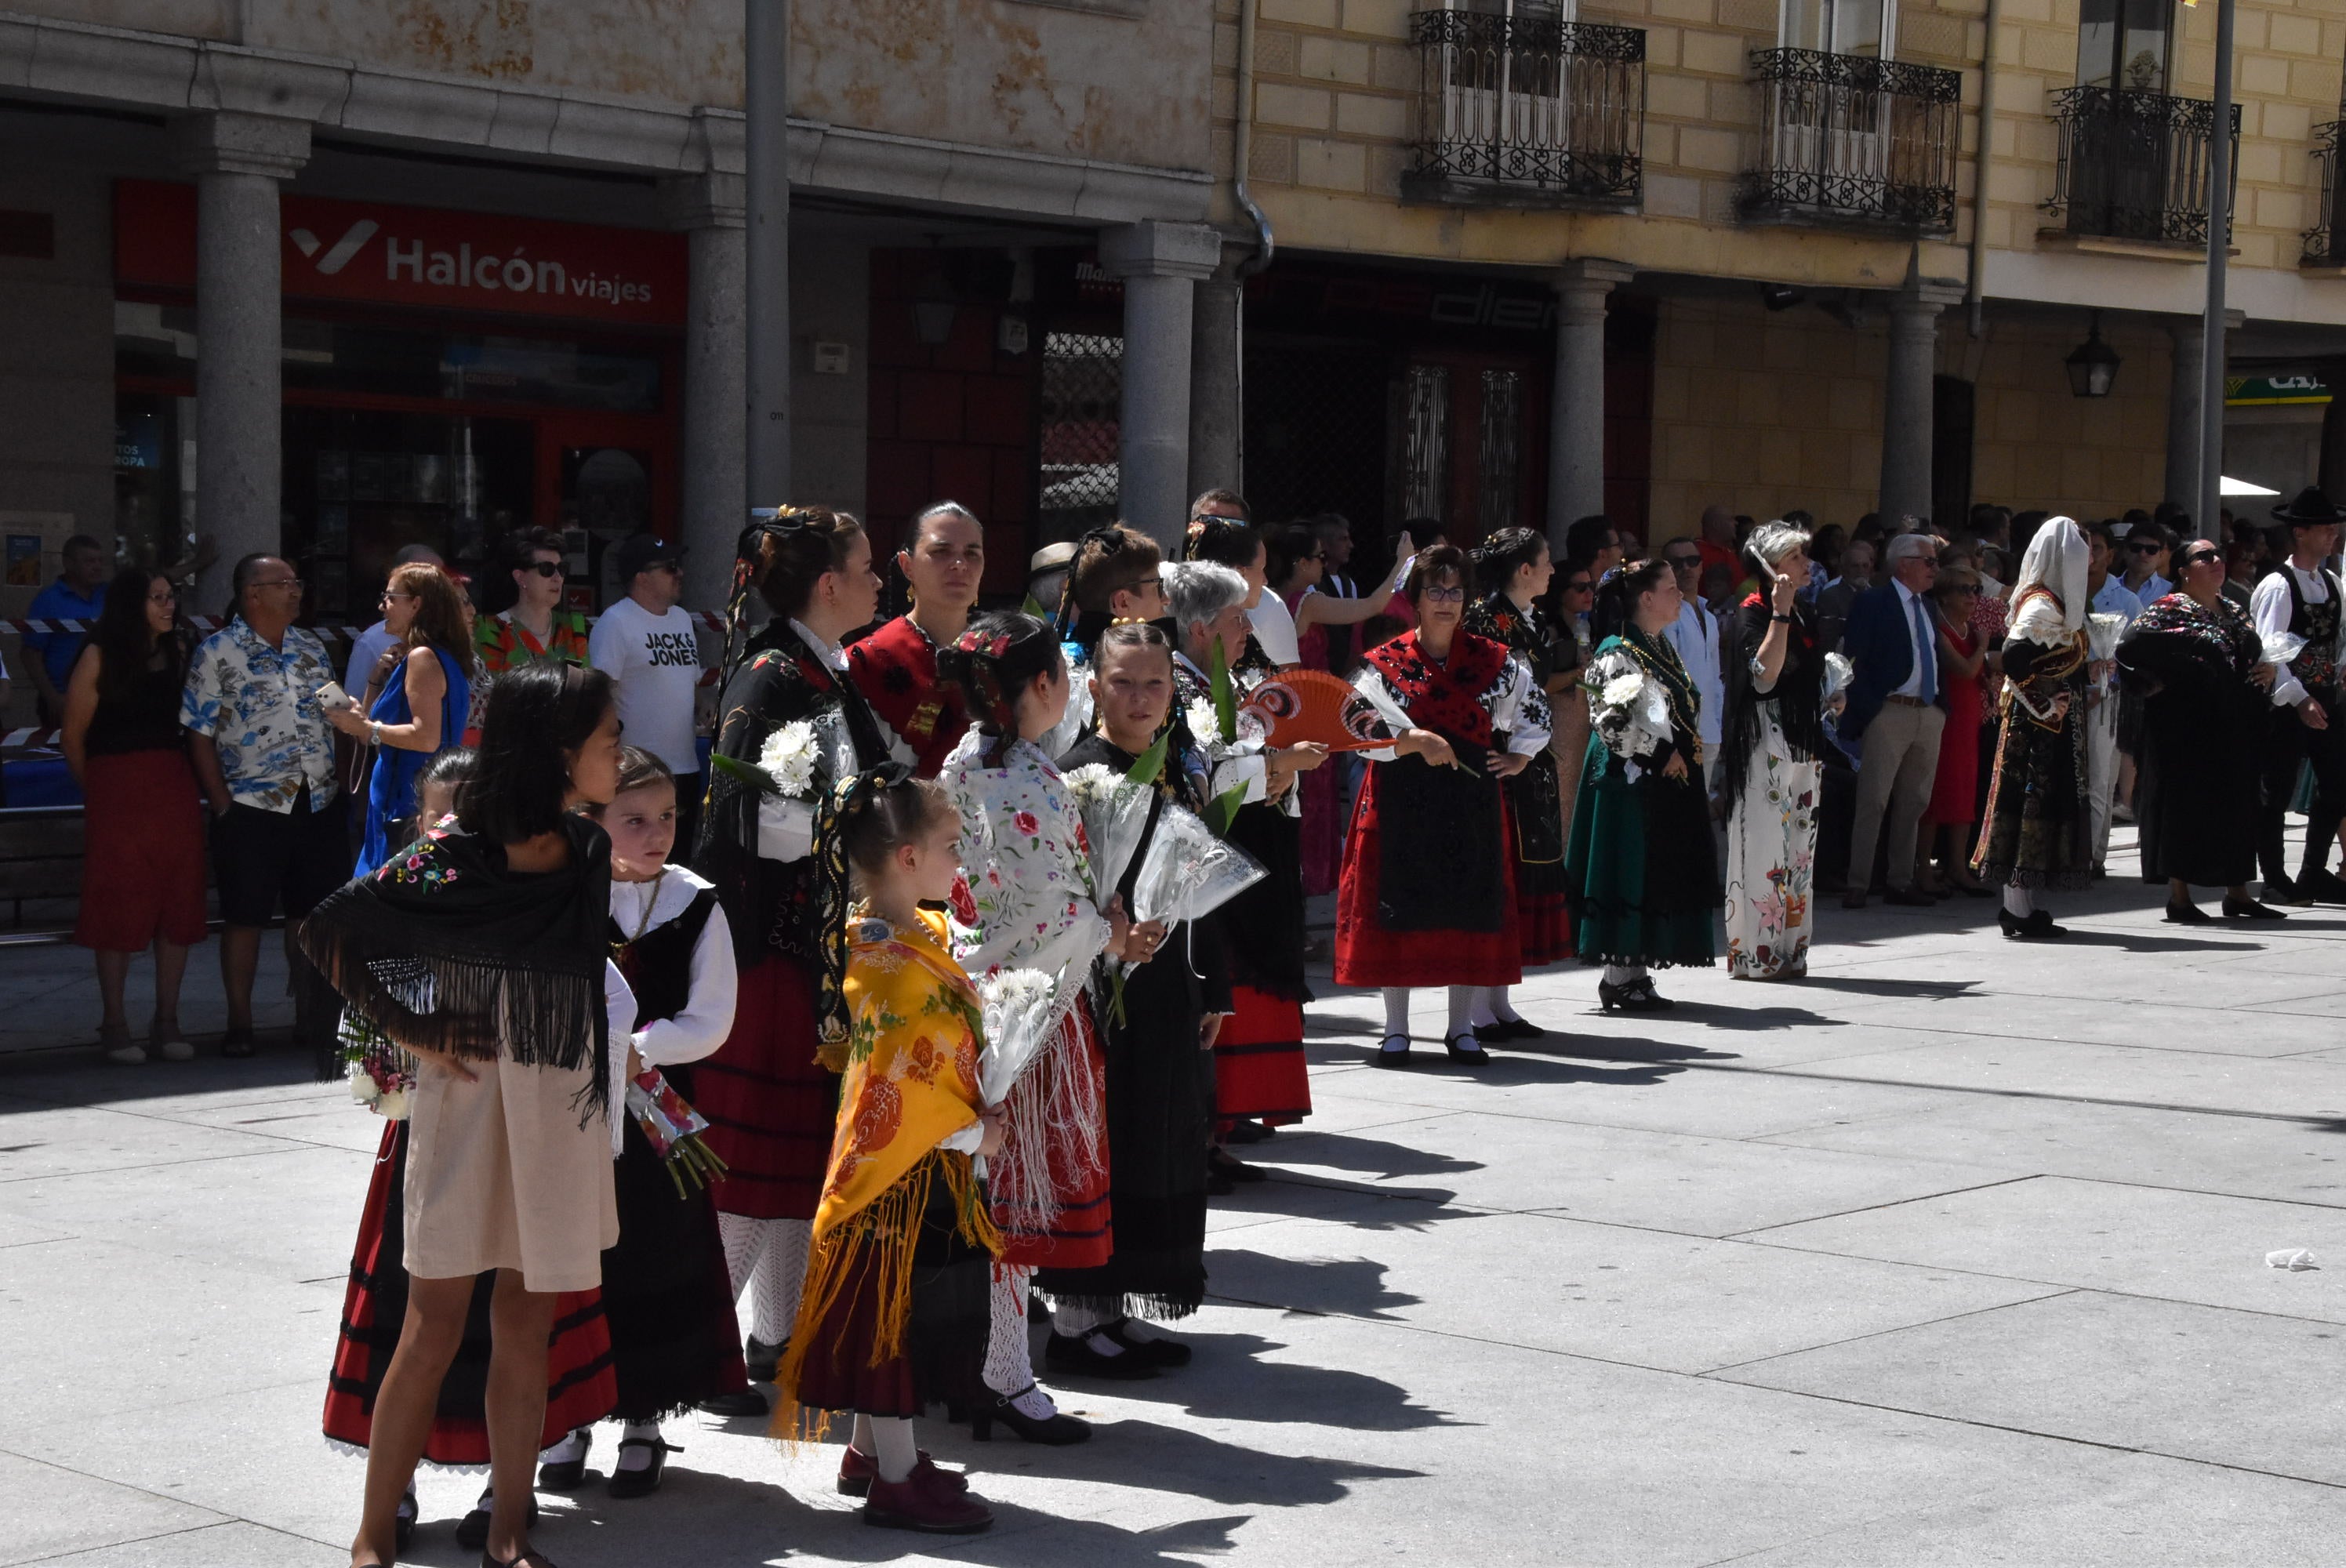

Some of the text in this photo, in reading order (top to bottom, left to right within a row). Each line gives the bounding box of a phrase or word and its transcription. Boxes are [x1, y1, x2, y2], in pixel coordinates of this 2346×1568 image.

[387, 237, 652, 305] Halcón viajes
[649, 649, 698, 666] JONES
